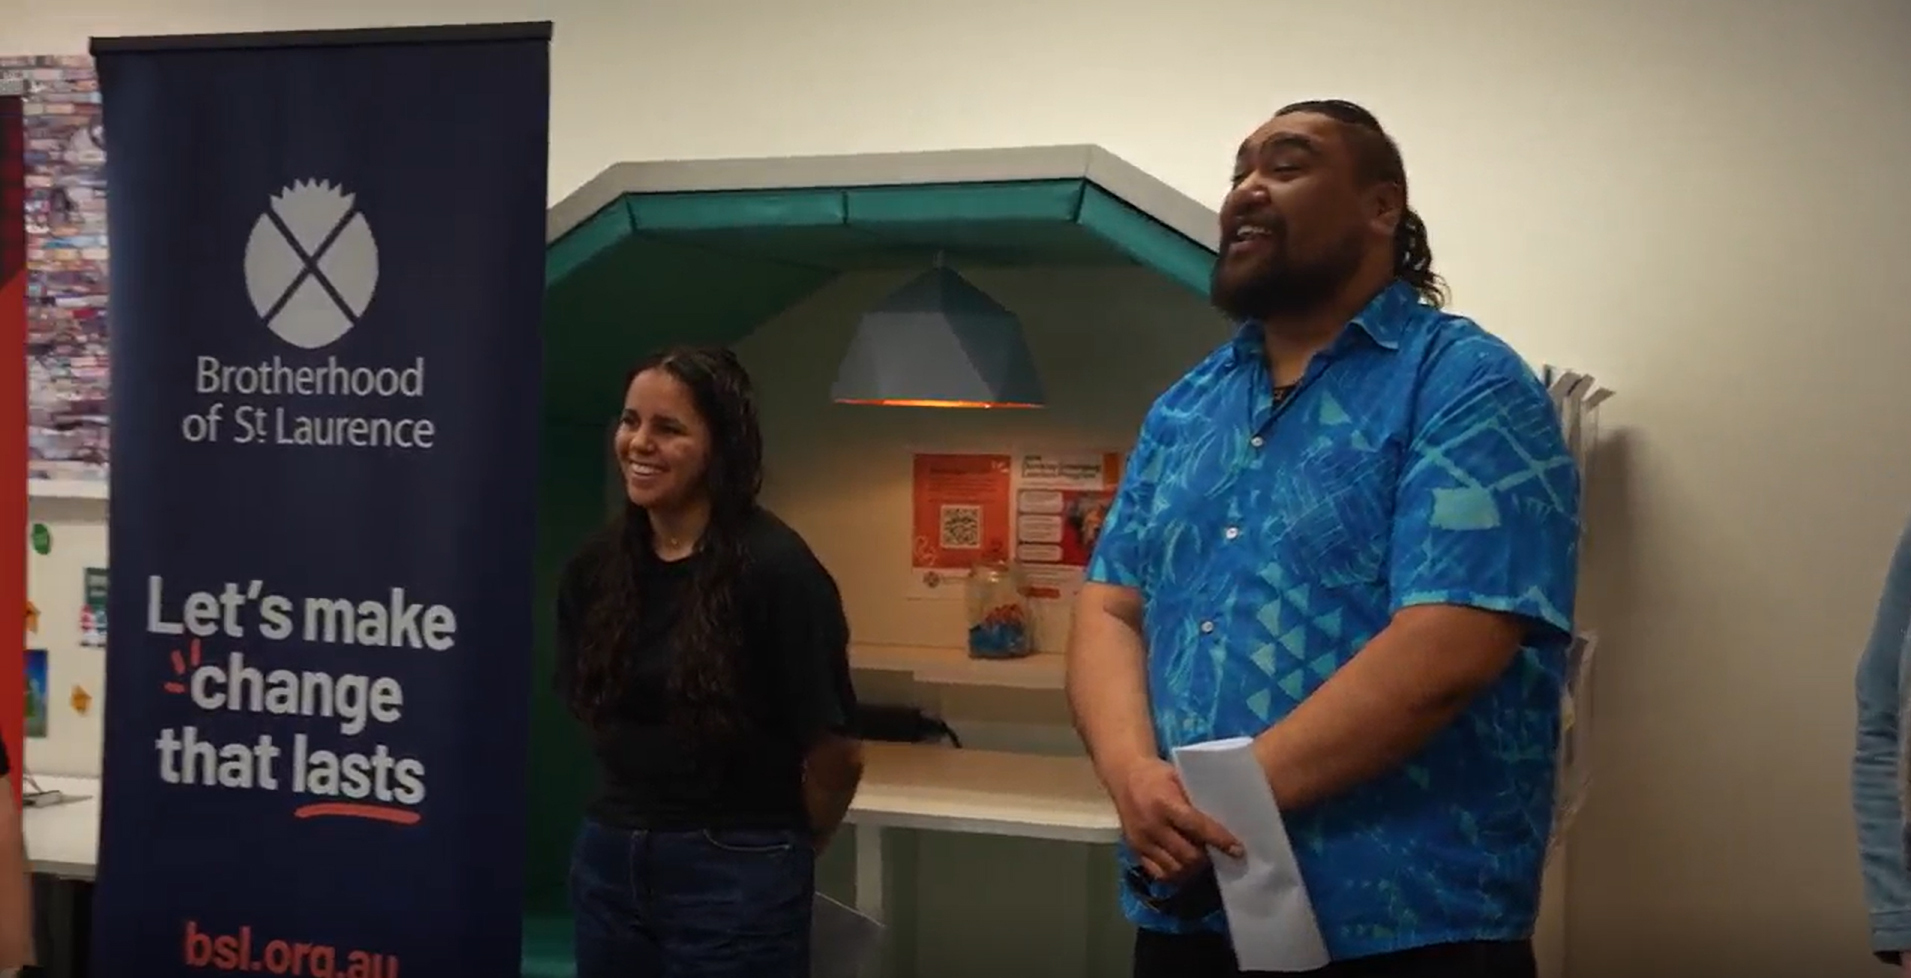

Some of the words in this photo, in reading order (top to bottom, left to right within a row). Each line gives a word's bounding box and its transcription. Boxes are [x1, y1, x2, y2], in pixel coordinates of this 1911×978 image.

[196, 355, 425, 398] Brotherhood
[182, 404, 224, 444] of
[276, 406, 435, 450] Laurence
[147, 575, 293, 639] Let's
[301, 588, 456, 650] make
[190, 652, 403, 734] change
[156, 726, 279, 791] that
[294, 733, 427, 806] lasts
